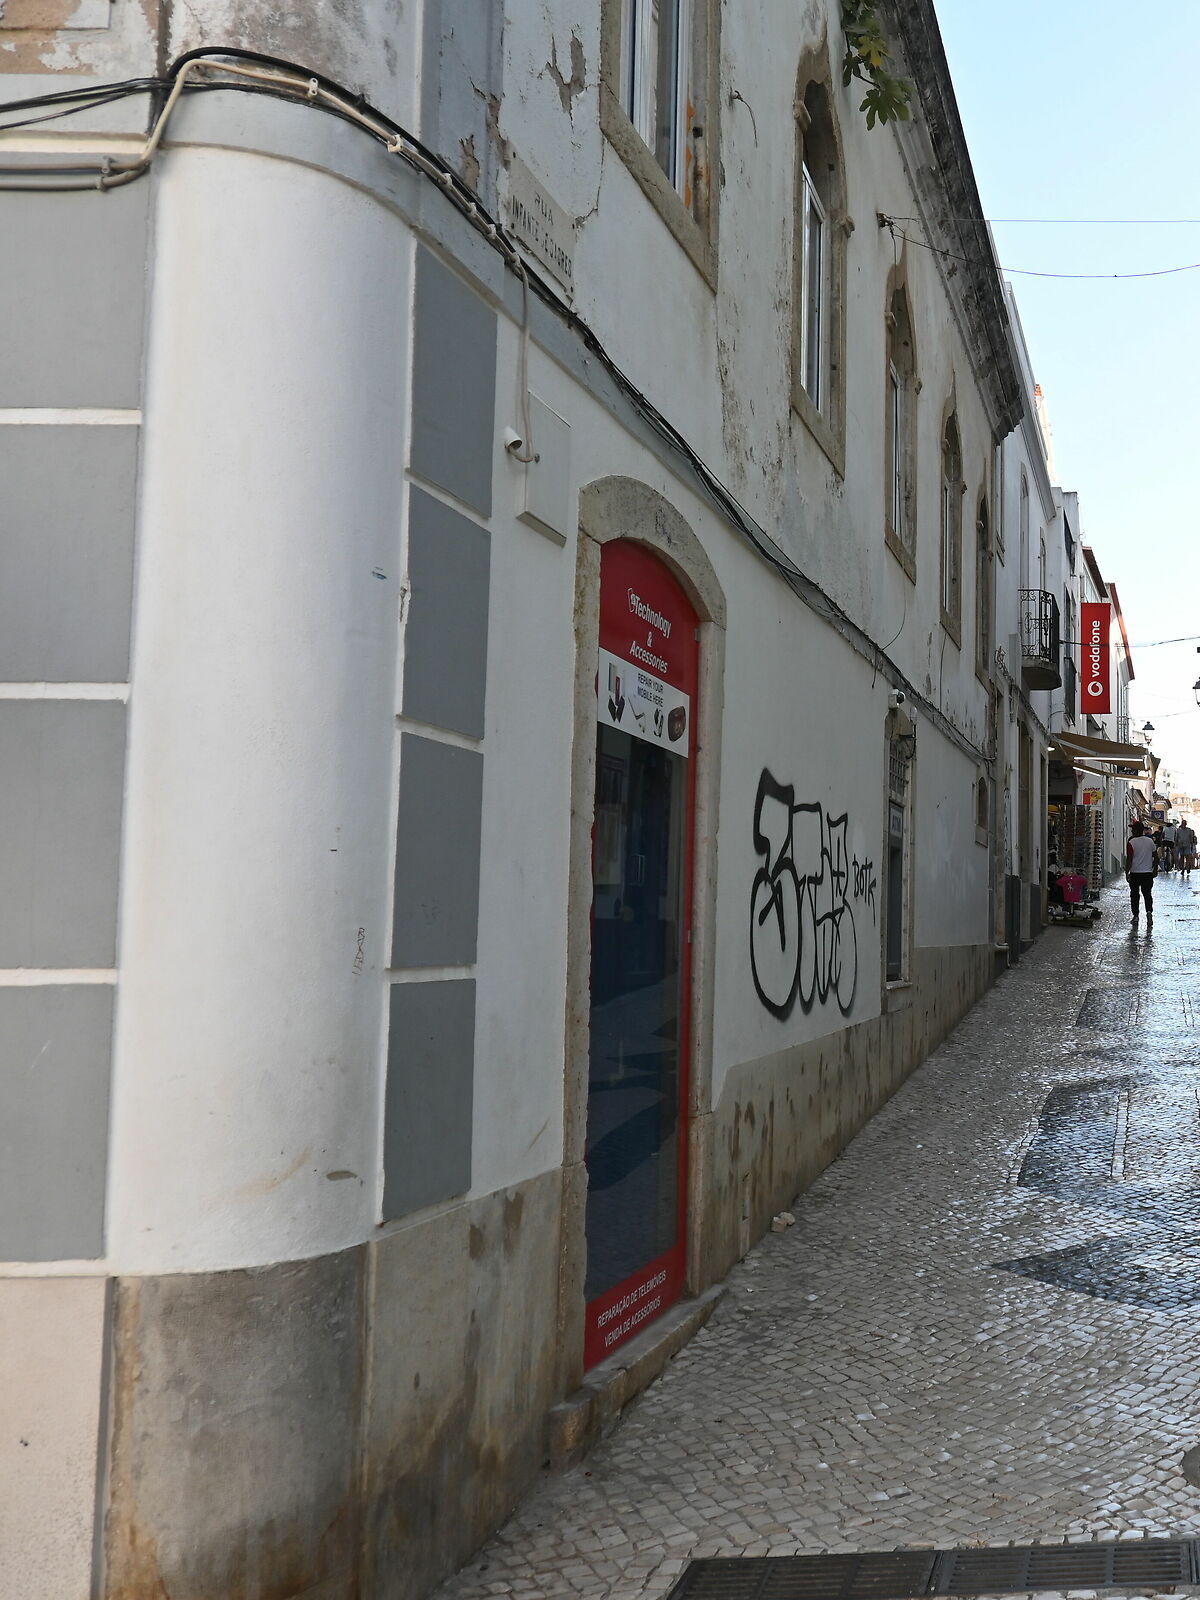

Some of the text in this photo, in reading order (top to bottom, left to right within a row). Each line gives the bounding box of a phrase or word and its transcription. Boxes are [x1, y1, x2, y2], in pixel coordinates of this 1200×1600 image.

[512, 194, 540, 242] INFANTE
[629, 640, 668, 674] Accessories
[647, 631, 653, 648] &
[1089, 620, 1101, 678] vodafone
[637, 672, 664, 694] REPAIR YOUR
[637, 686, 664, 708] MOBILE HERE
[597, 1269, 666, 1329] REPARAÇÃO DE TELEMÓVEIS
[603, 1295, 661, 1348] VENDA DE ACESSÓRIOS
